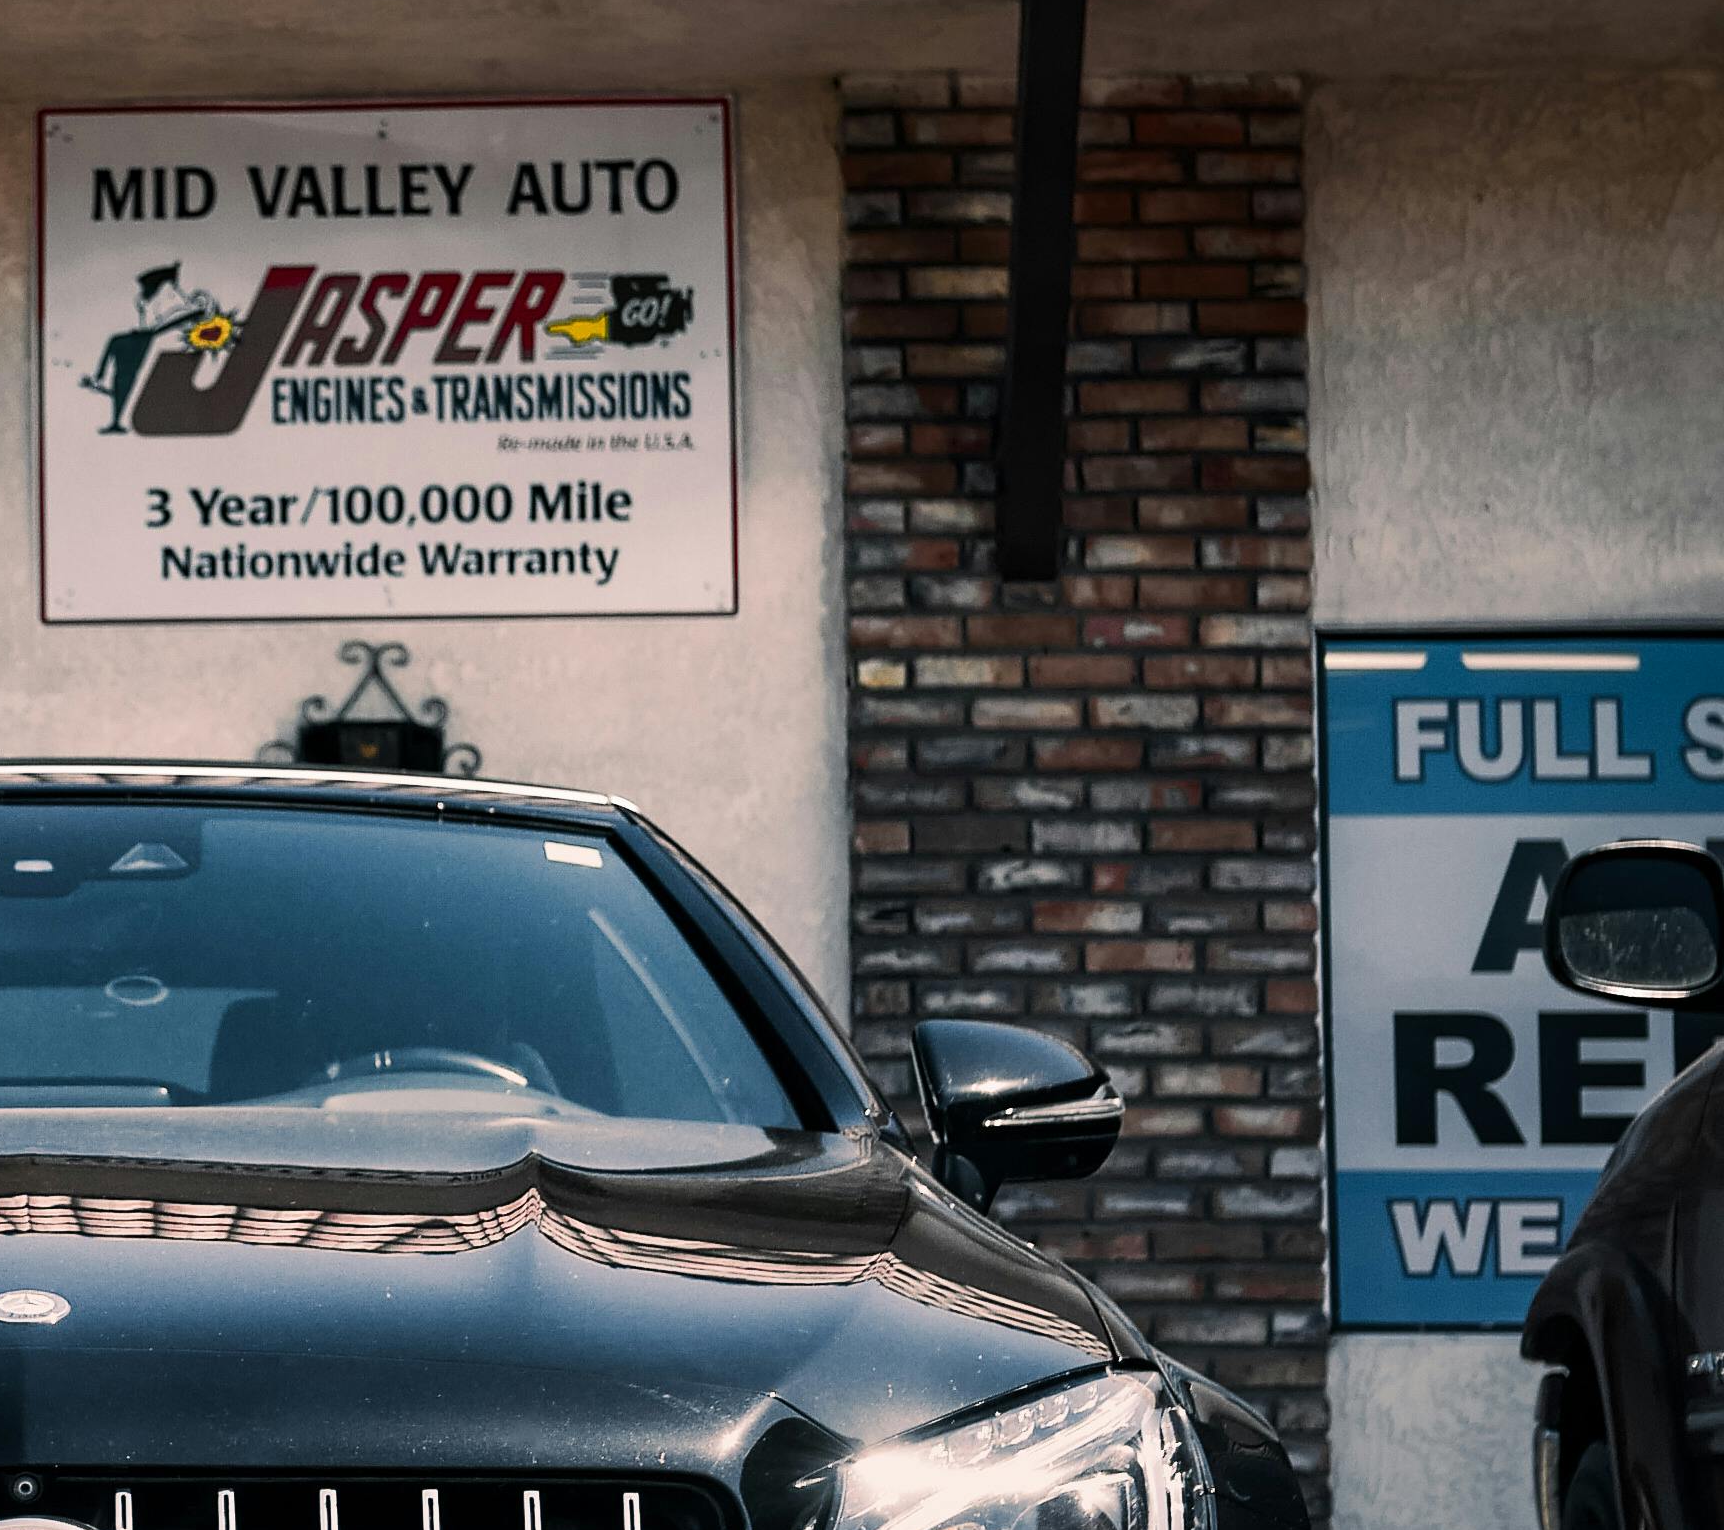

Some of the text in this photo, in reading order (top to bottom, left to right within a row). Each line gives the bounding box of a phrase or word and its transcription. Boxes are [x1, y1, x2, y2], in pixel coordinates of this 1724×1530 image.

[90, 159, 679, 221] MID VALLEY AUTO
[621, 294, 672, 327] GO!
[131, 264, 566, 437] JASPER
[271, 375, 407, 425] ENGINES
[432, 370, 693, 422] TRANSMISSIONS
[145, 479, 634, 528] 3 Year/100,000 Mile
[160, 540, 621, 585] Nationwide Warranty
[1393, 697, 1655, 783] FULL
[1387, 1198, 1564, 1277] WE
